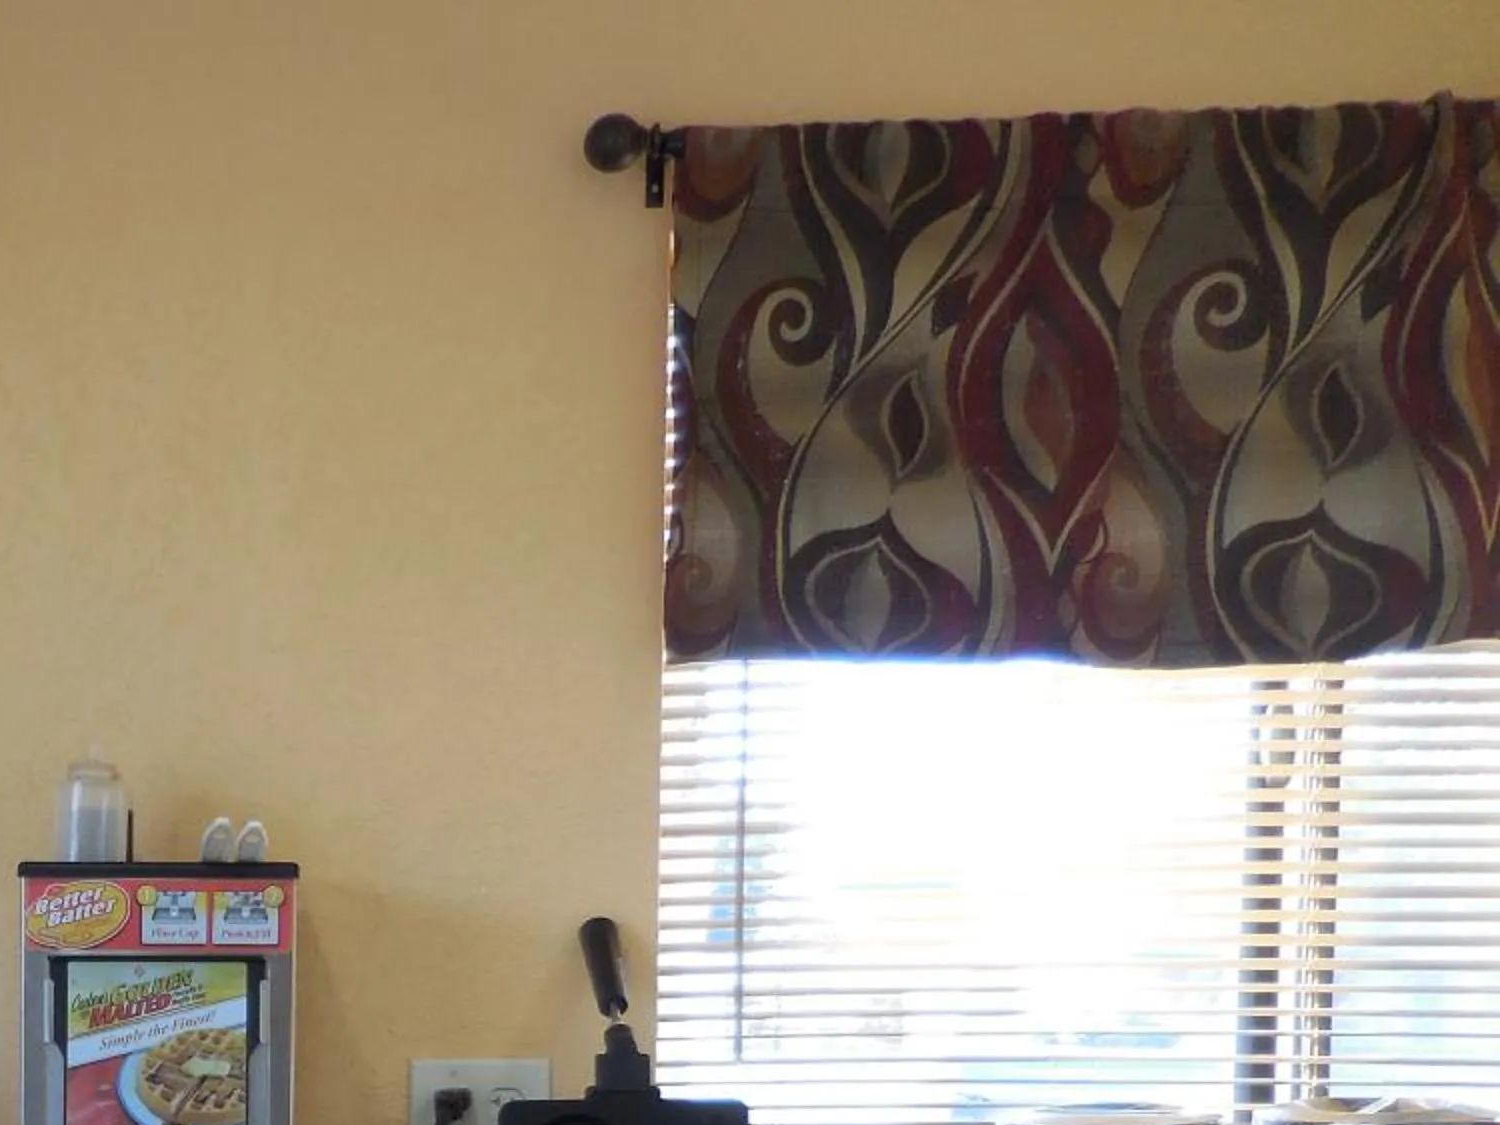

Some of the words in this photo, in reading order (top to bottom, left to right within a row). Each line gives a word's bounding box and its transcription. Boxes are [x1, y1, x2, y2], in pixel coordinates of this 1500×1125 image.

[36, 888, 103, 914] Better
[48, 900, 115, 926] Batter
[99, 1029, 145, 1051] Simply
[147, 1023, 170, 1037] the
